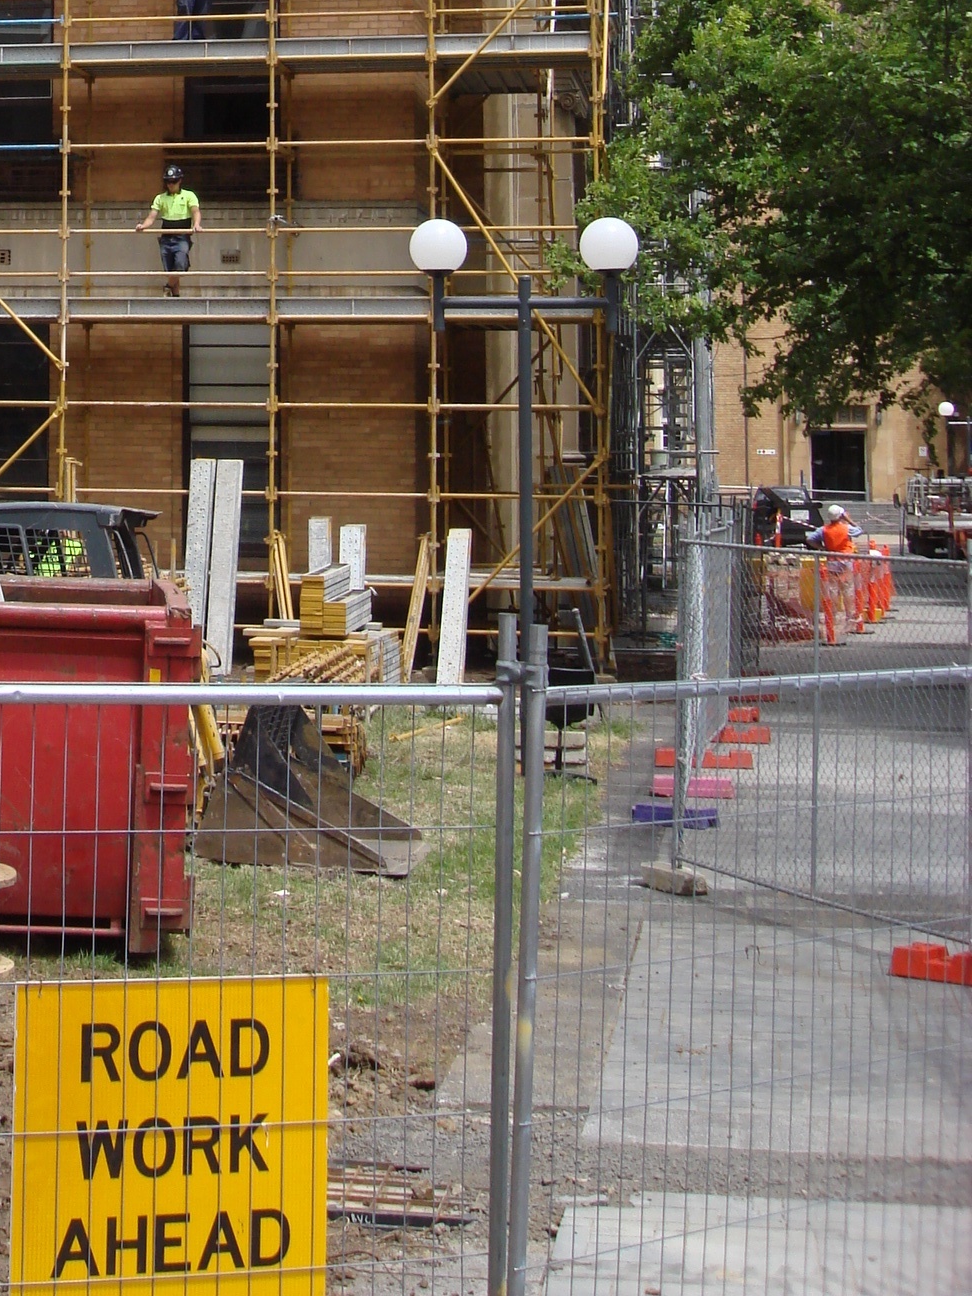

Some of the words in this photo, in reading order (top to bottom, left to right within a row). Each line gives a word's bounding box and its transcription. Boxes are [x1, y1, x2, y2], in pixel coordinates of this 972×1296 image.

[80, 1017, 271, 1084] ROAD
[76, 1112, 270, 1181] WORK
[50, 1208, 291, 1279] AHEAD
